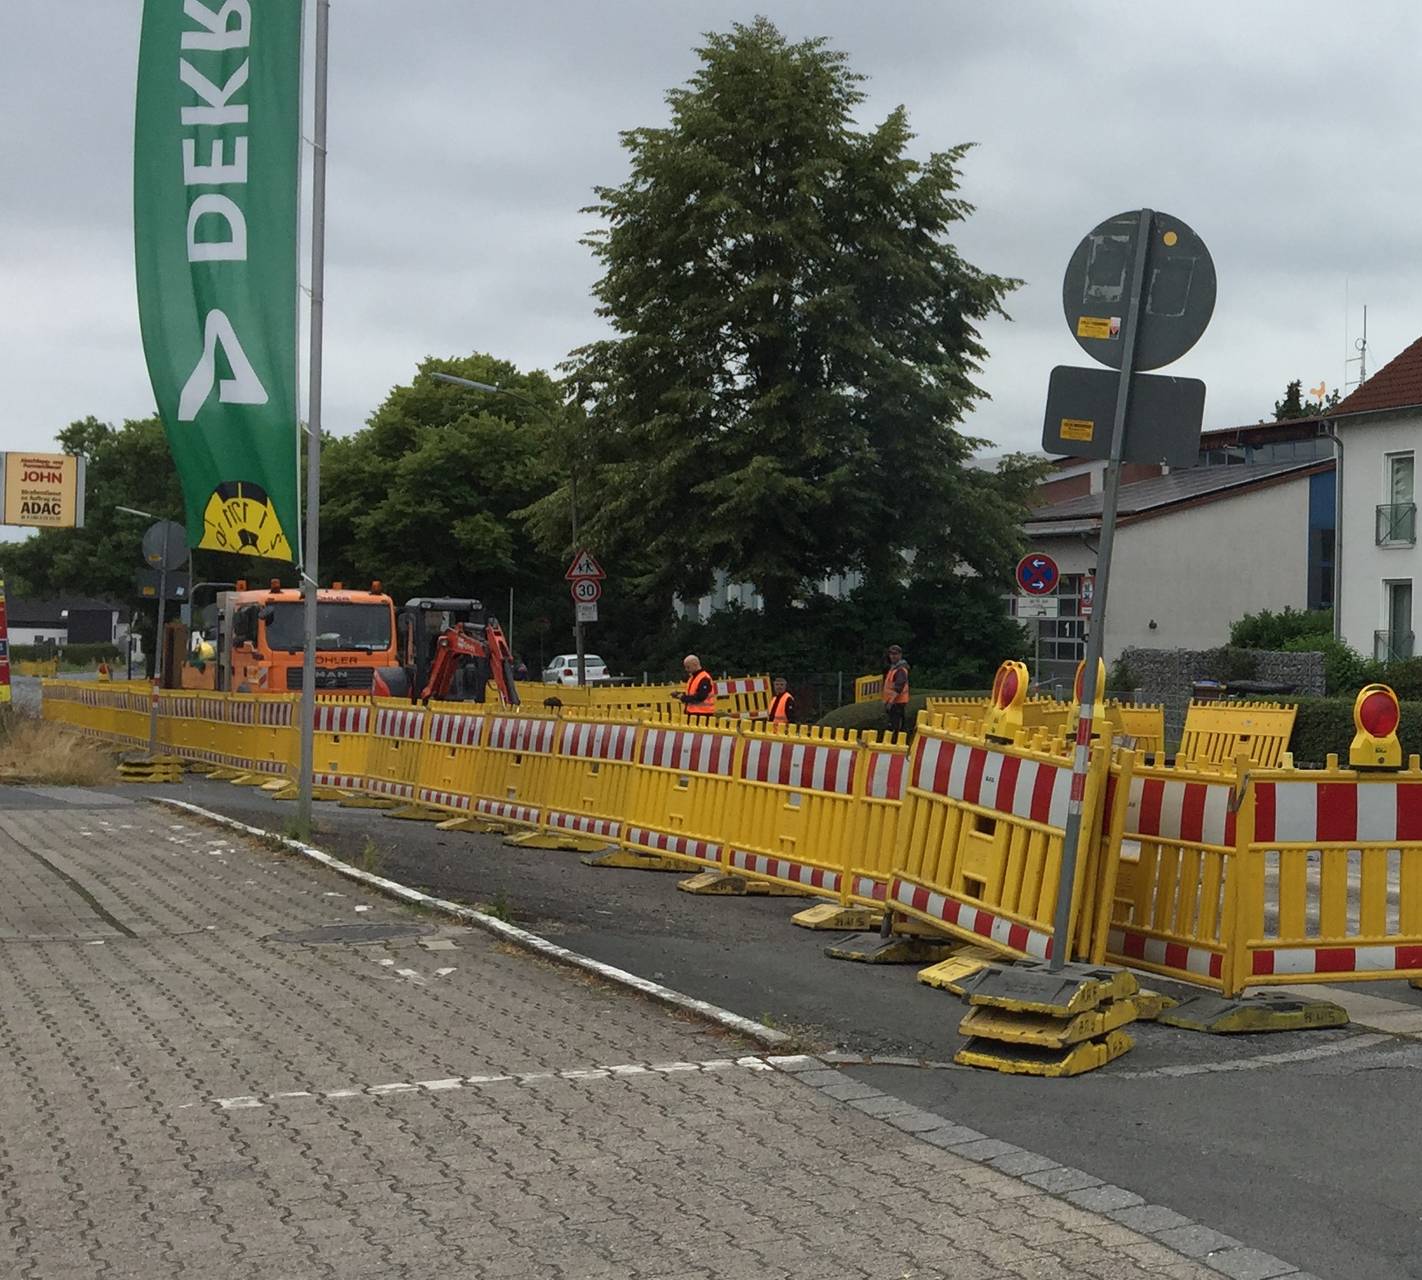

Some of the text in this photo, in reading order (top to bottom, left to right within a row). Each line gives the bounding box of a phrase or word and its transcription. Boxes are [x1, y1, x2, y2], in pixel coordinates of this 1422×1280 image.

[21, 471, 63, 484] JOHN
[21, 502, 61, 515] ADAC
[579, 584, 594, 597] 30
